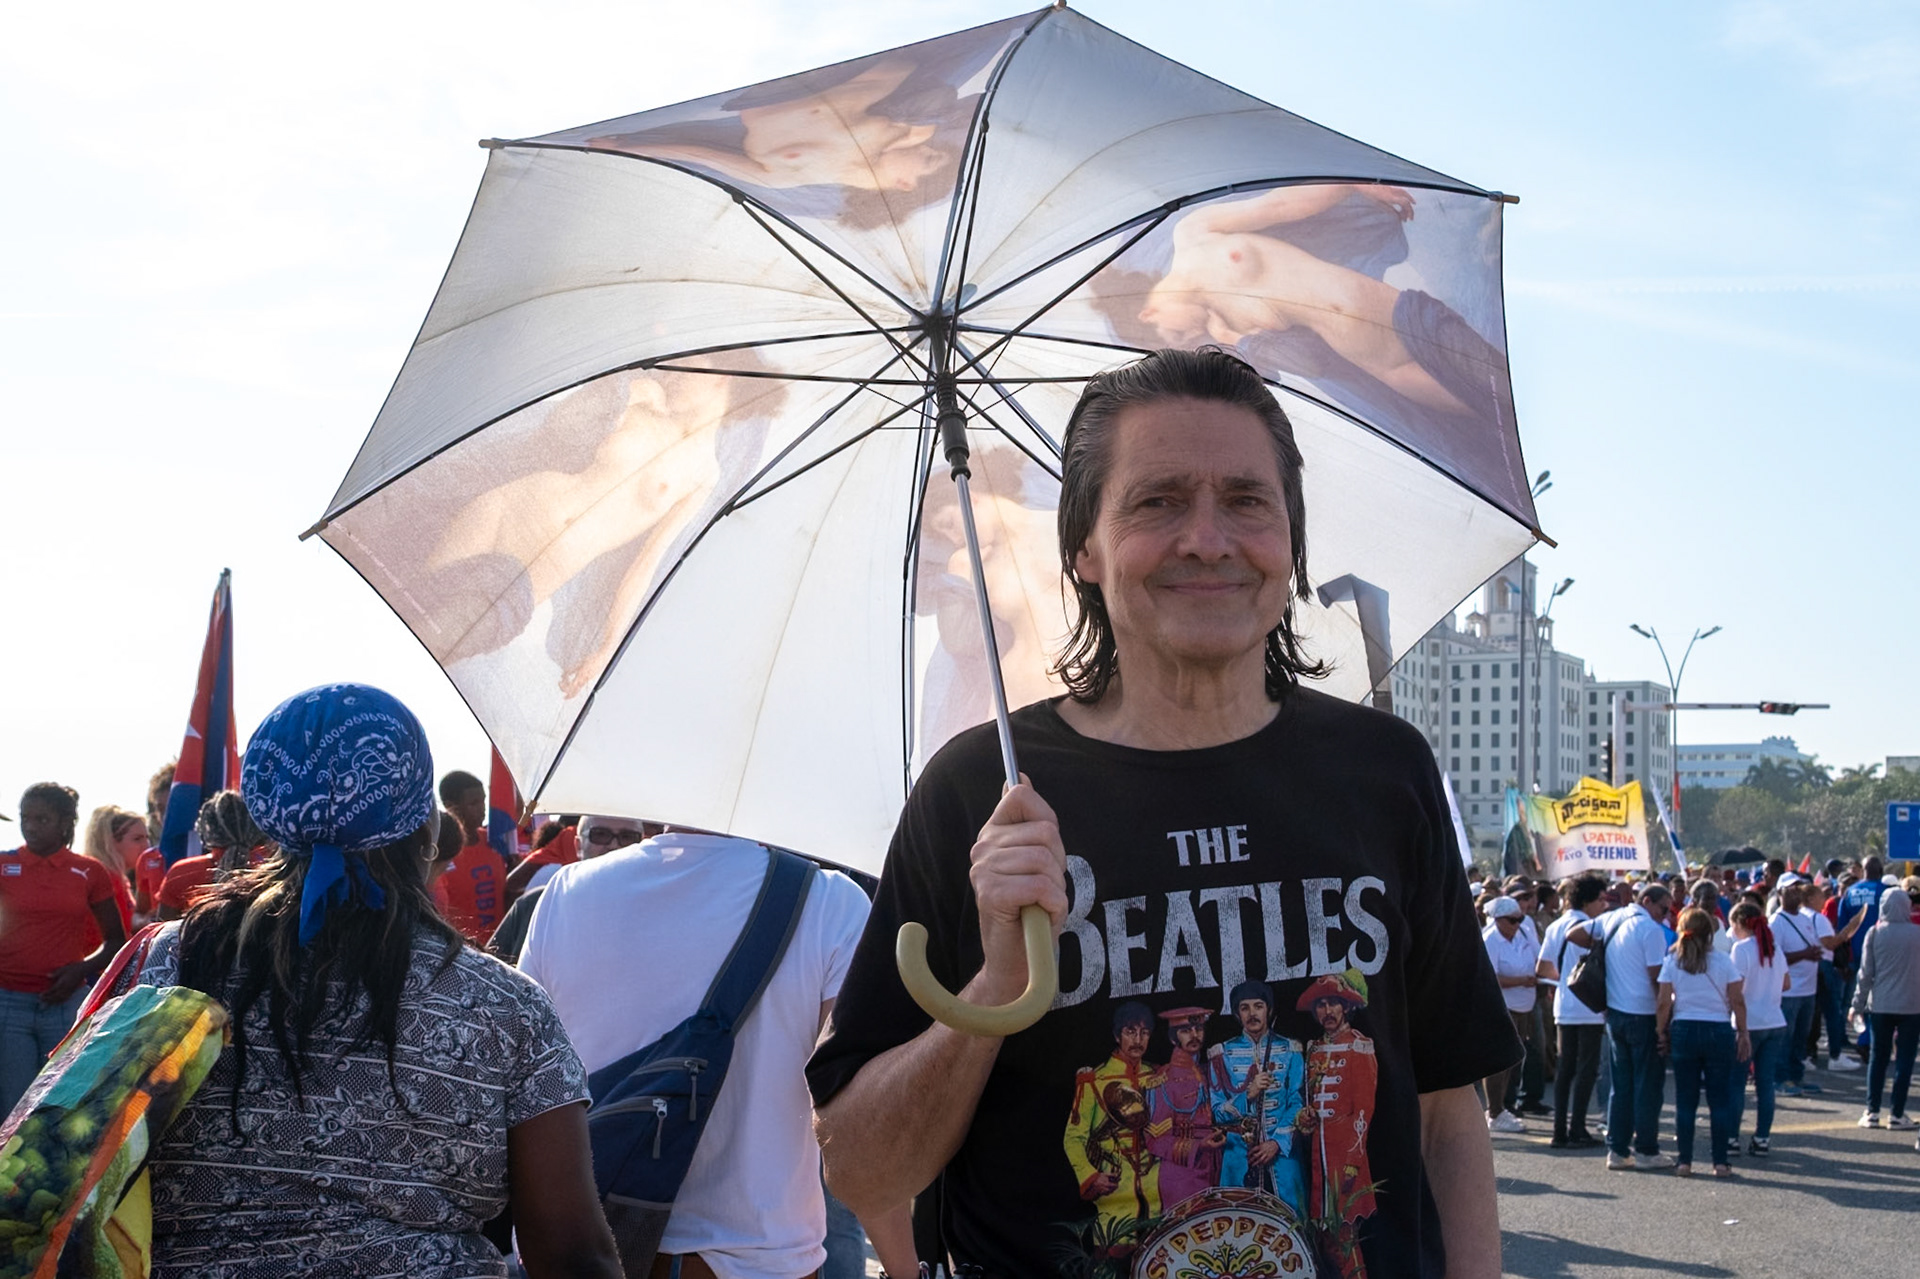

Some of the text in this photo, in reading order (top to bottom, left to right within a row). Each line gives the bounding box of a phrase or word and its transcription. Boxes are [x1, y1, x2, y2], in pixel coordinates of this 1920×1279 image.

[1166, 824, 1251, 867] THE
[471, 864, 496, 928] CUBA
[1050, 854, 1390, 1016] BEATLES
[1169, 1216, 1304, 1273] PEPPERS
